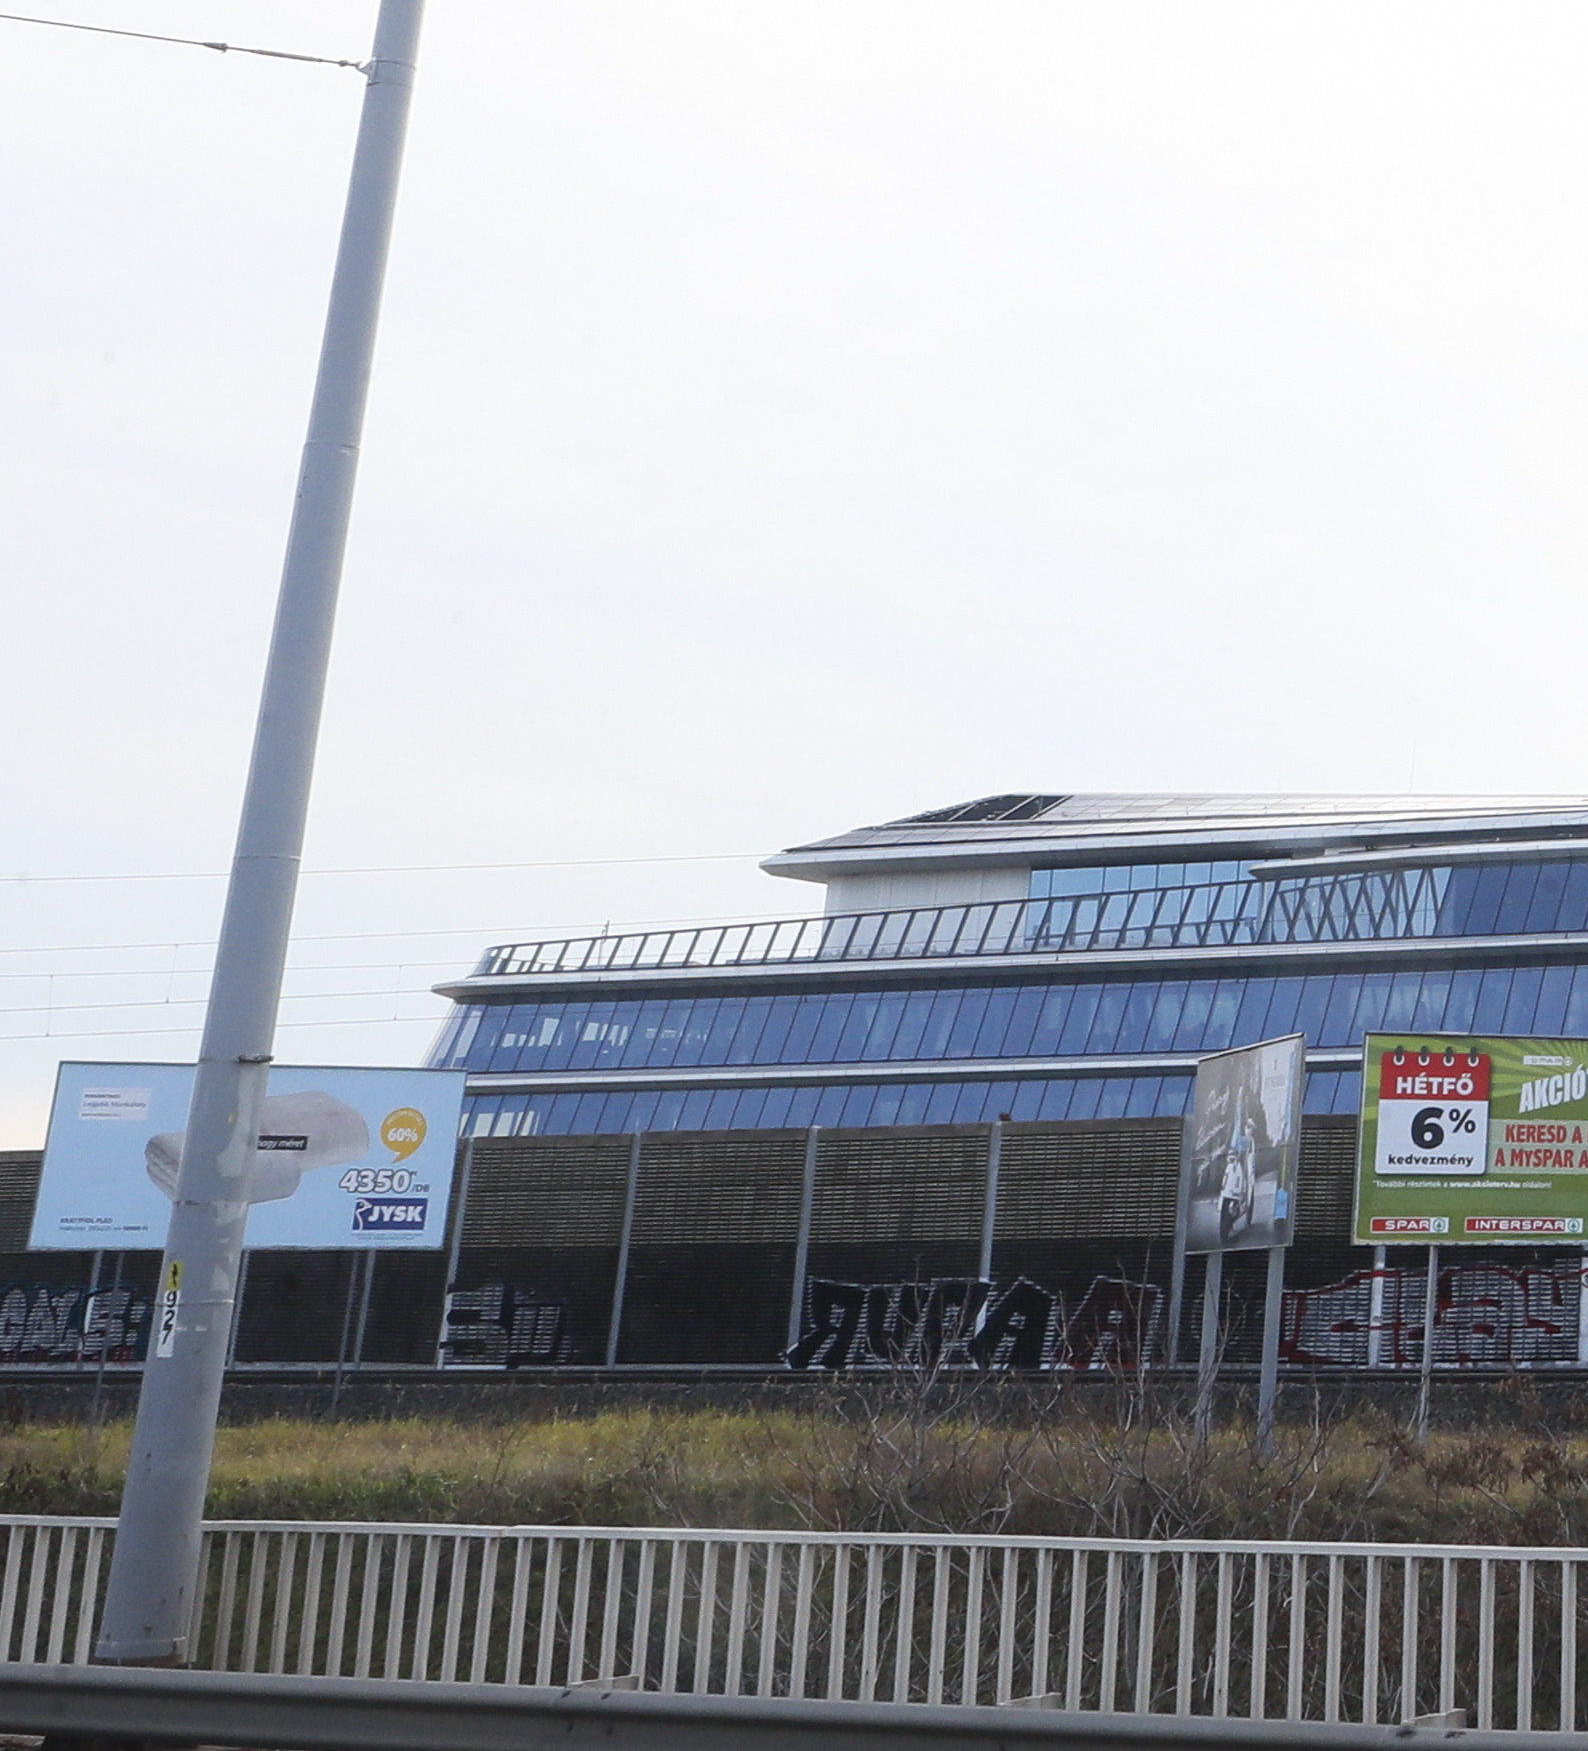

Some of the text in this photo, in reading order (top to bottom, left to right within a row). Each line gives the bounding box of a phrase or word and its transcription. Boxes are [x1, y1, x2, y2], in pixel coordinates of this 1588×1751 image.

[1396, 1072, 1474, 1096] HÉTFŐ
[387, 1128, 418, 1142] 60%
[1411, 1107, 1476, 1149] 6%
[1505, 1124, 1567, 1143] KERESD
[1571, 1125, 1583, 1144] A
[1388, 1153, 1474, 1167] kedvezmény
[1494, 1148, 1505, 1166] A
[1510, 1149, 1574, 1167] MYSPAR
[339, 1169, 411, 1193] 4350
[368, 1205, 424, 1222] JYSK
[1385, 1220, 1430, 1230] SPAR
[1475, 1220, 1565, 1230] INTERSPAR
[162, 1290, 177, 1345] 927
